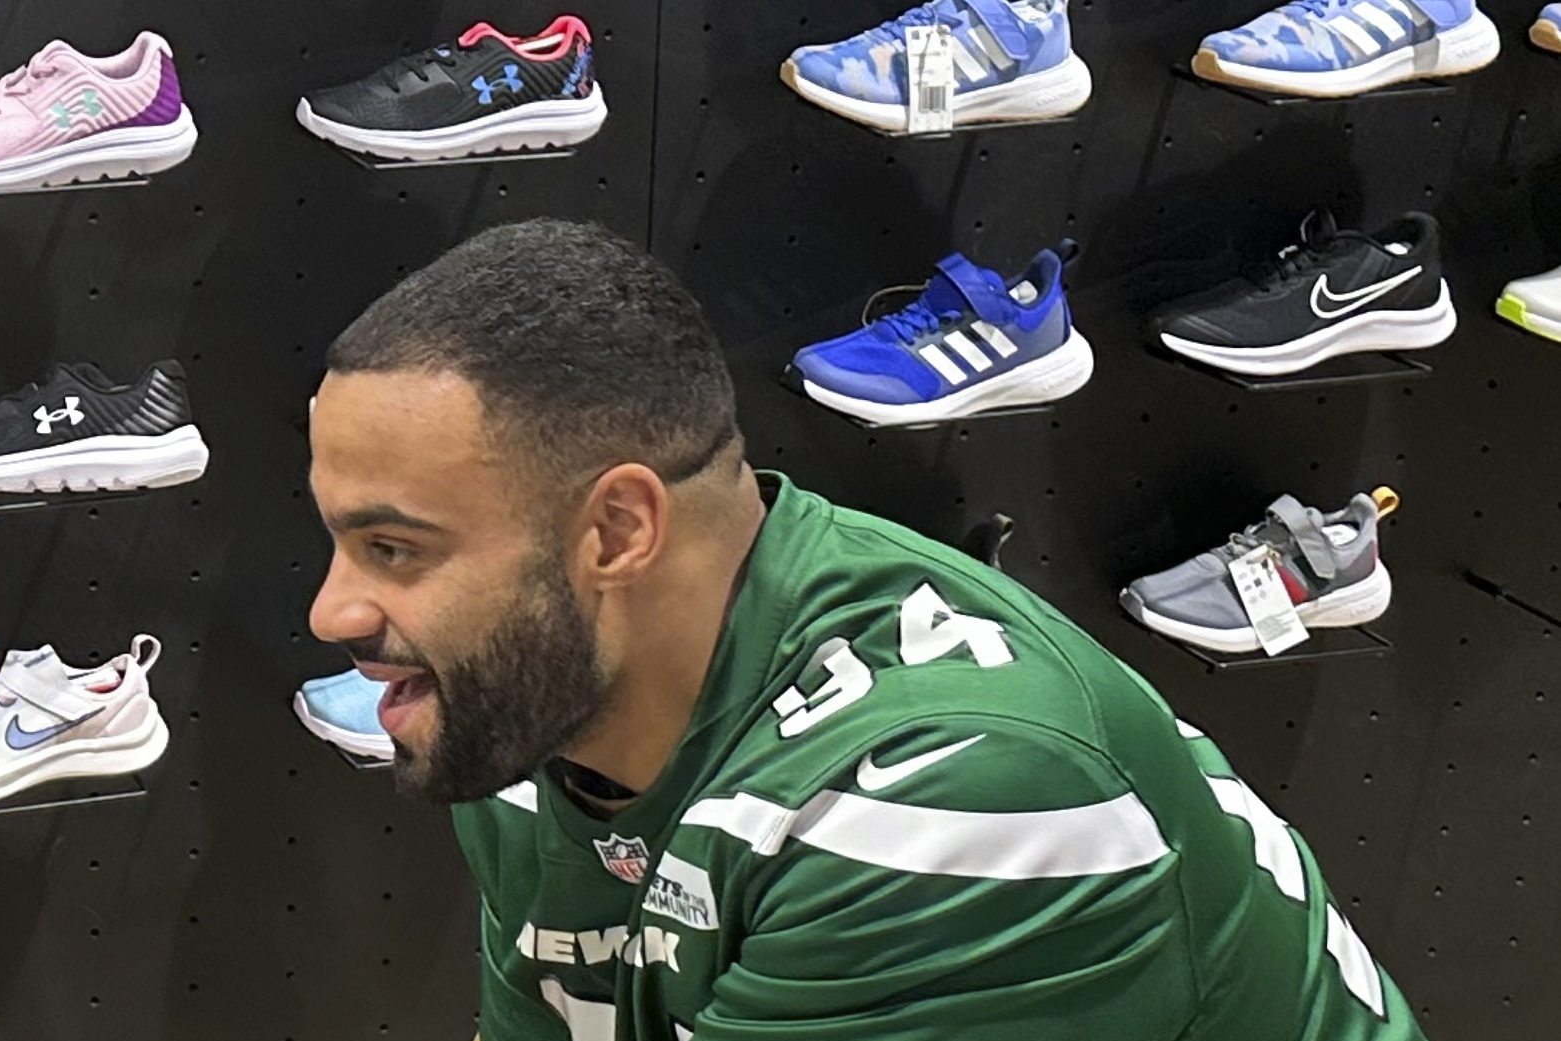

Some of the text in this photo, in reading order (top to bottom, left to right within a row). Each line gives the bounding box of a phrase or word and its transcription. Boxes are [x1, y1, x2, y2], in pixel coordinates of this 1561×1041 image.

[772, 582, 1014, 738] 34
[651, 874, 684, 897] ETS
[645, 889, 710, 926] MMUNITY
